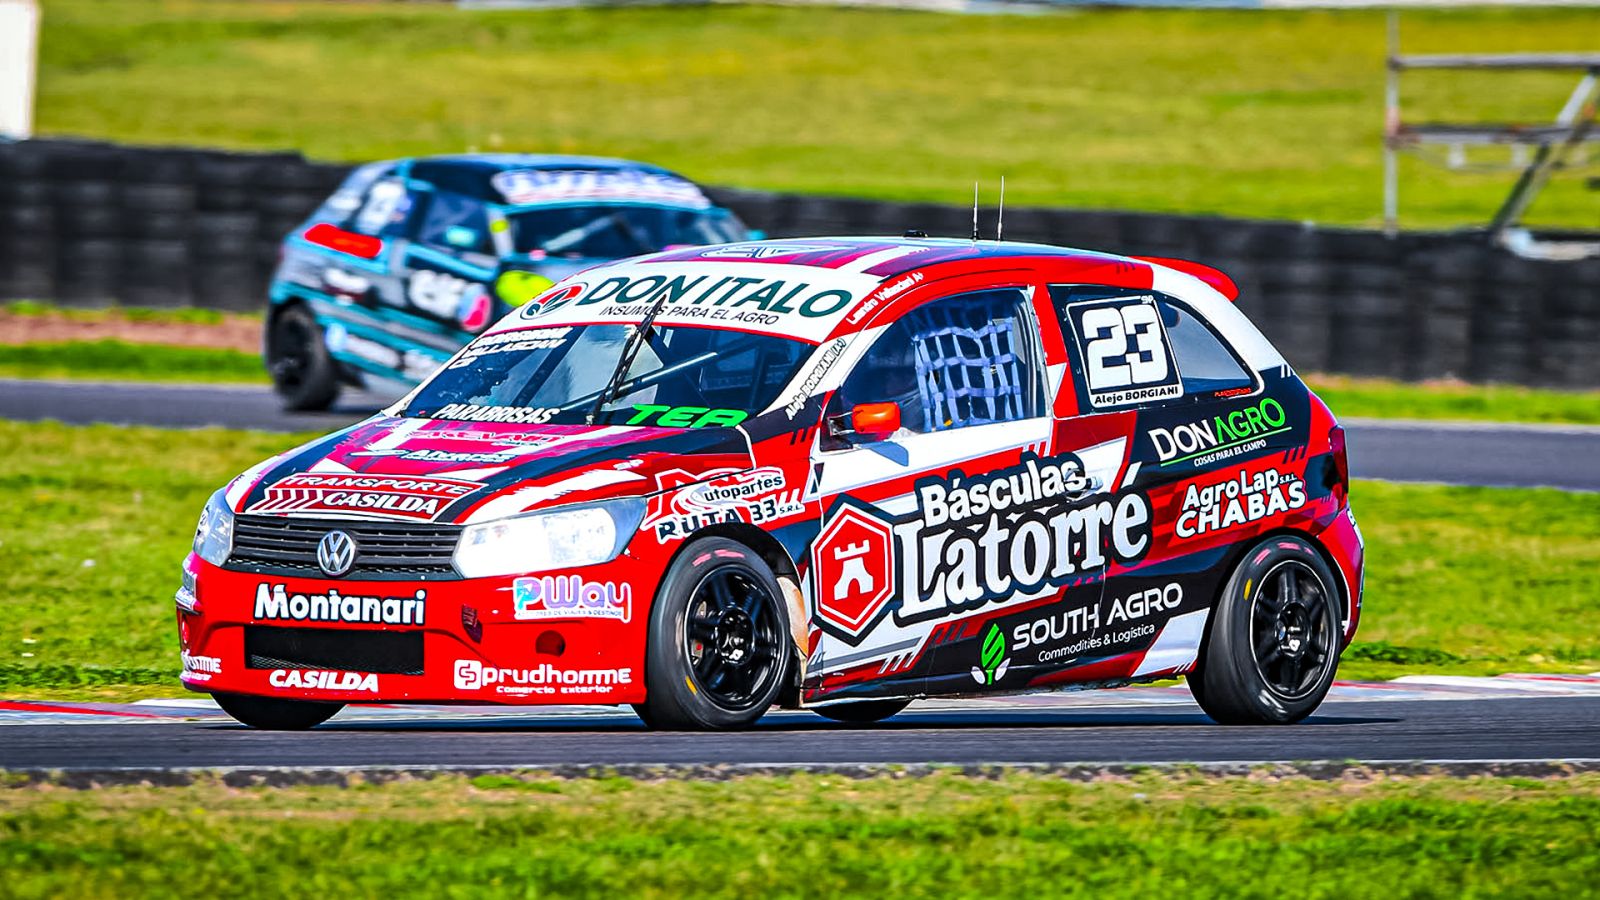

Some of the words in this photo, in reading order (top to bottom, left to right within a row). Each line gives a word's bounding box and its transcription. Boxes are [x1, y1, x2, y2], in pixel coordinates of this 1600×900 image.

[576, 275, 709, 306] DON
[691, 276, 852, 318] ITALO
[599, 305, 668, 316] INSUMOS
[667, 307, 709, 318] PARA
[711, 309, 729, 320] EL
[731, 312, 780, 326] AGRO
[1082, 304, 1168, 390] 23
[1094, 394, 1123, 404] Alejo
[1125, 386, 1178, 401] BORGIANI
[431, 404, 560, 424] PARABRISAS
[1193, 455, 1216, 467] COSAS
[1216, 450, 1234, 462] PARA
[1234, 448, 1243, 456] EL
[1243, 439, 1267, 454] CAMPO
[284, 475, 474, 495] TRANSPORTE
[323, 492, 441, 515] CASILDA
[1176, 481, 1306, 538] CHABAS
[658, 508, 741, 540] RUTA
[750, 498, 776, 521] 33
[254, 583, 426, 625] Montanari
[1012, 603, 1100, 651] SOUTH
[1106, 583, 1183, 626] AGRO
[1038, 636, 1102, 662] Commodities
[1103, 634, 1111, 645] &
[269, 669, 379, 692] CASILDA
